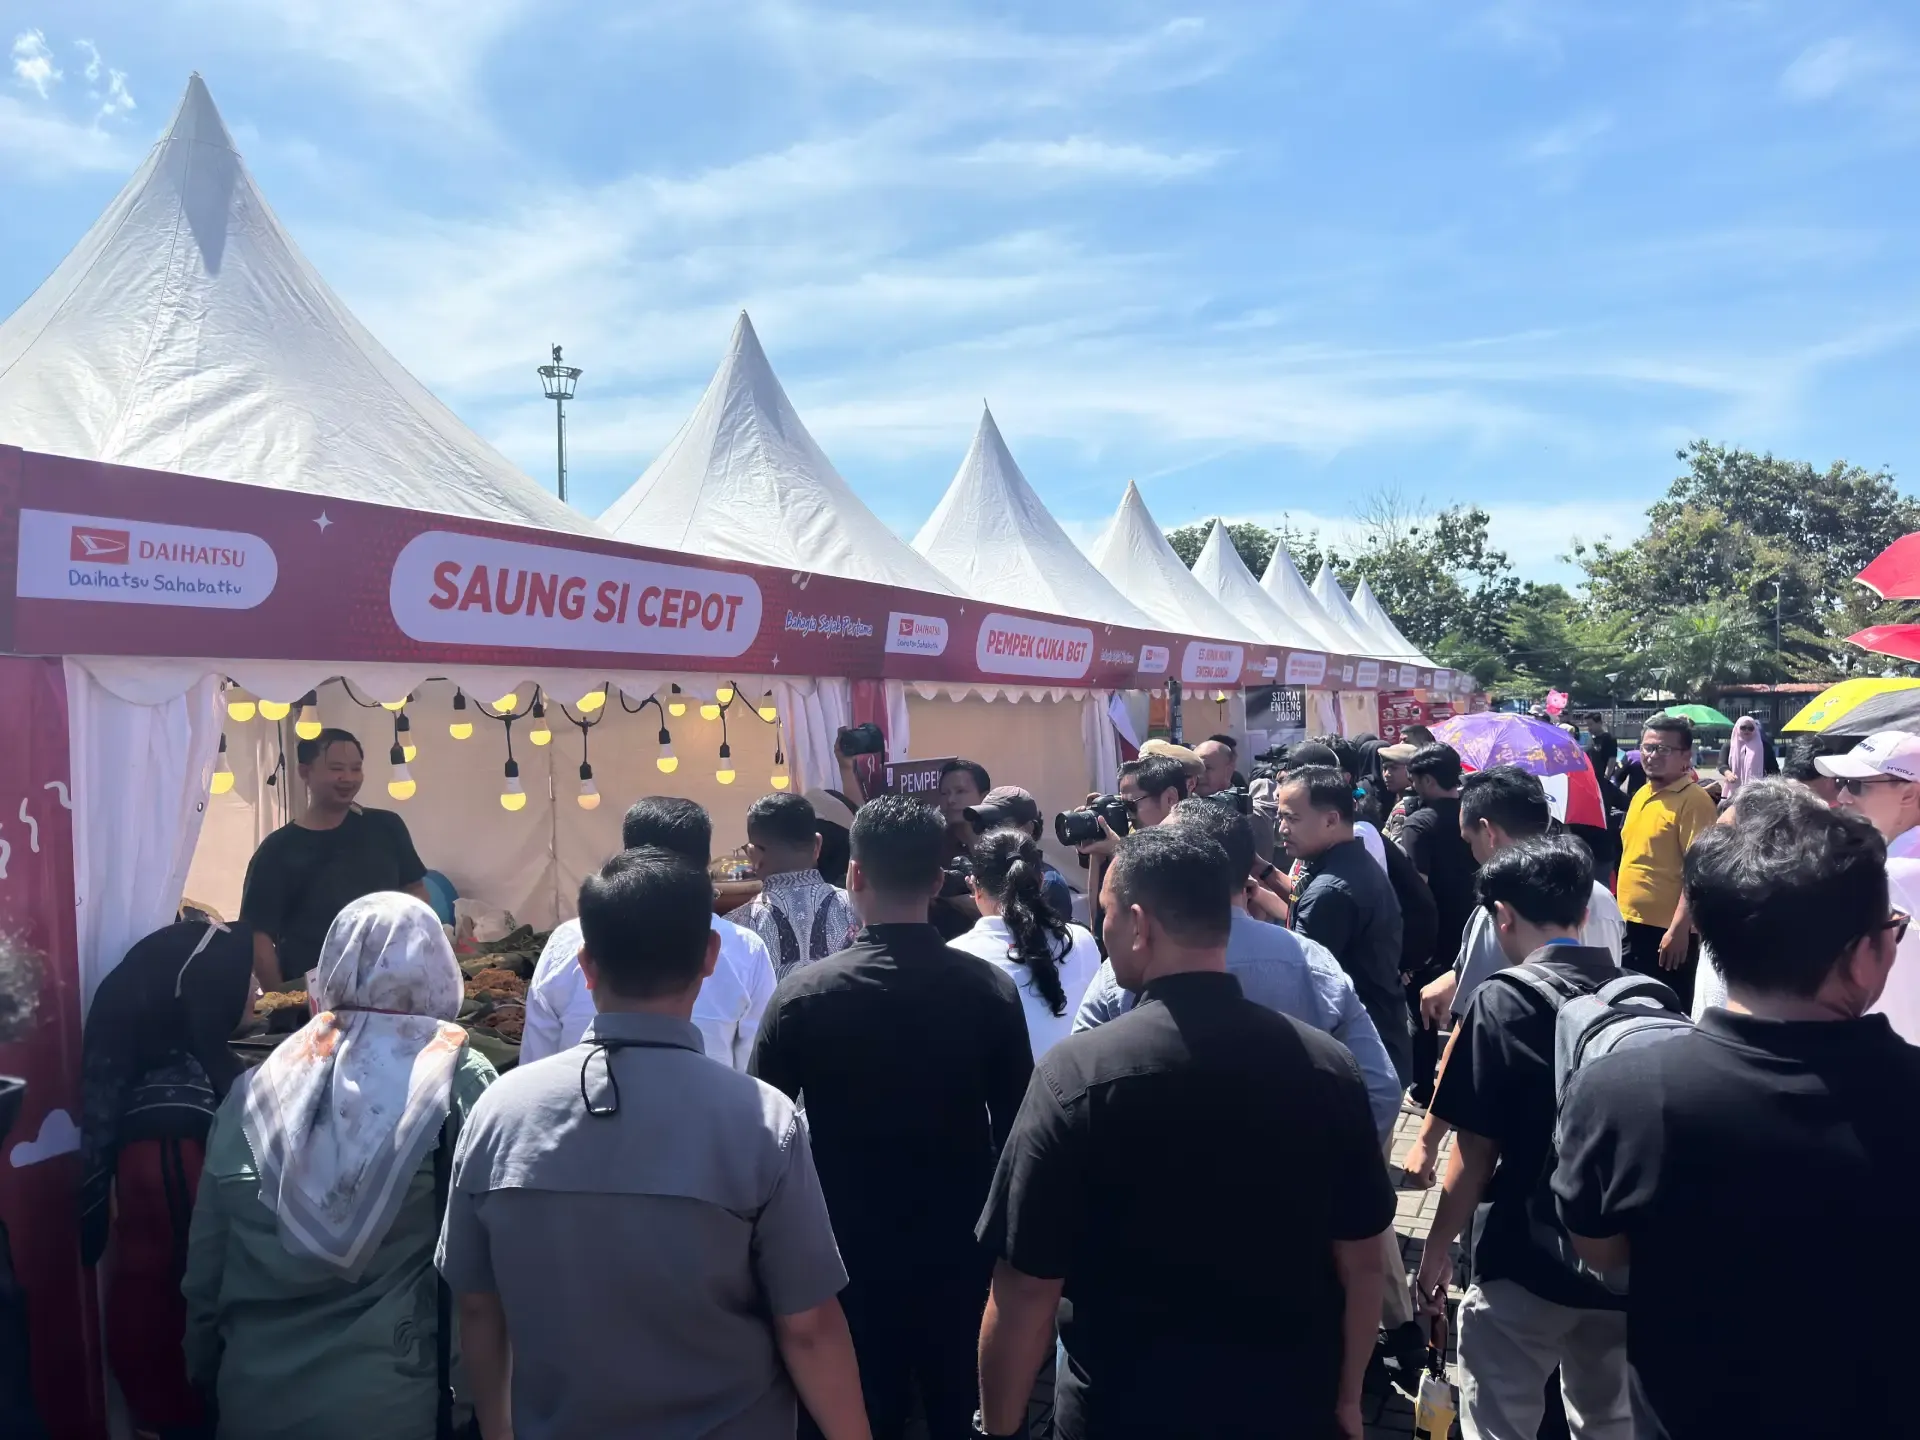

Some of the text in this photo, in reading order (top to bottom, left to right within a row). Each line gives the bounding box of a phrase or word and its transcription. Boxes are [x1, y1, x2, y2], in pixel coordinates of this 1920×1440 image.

[139, 540, 245, 567] DAIHATSU
[69, 569, 149, 588] Daihatsu
[429, 560, 743, 632] SAUNG SI CEPOT
[986, 629, 1035, 658] PEMPEK
[1036, 637, 1064, 661] CUKA
[1066, 641, 1088, 662] BGT
[1272, 691, 1301, 702] SIOMAY
[1270, 701, 1301, 712] ENTENG
[1276, 711, 1301, 722] JODOH
